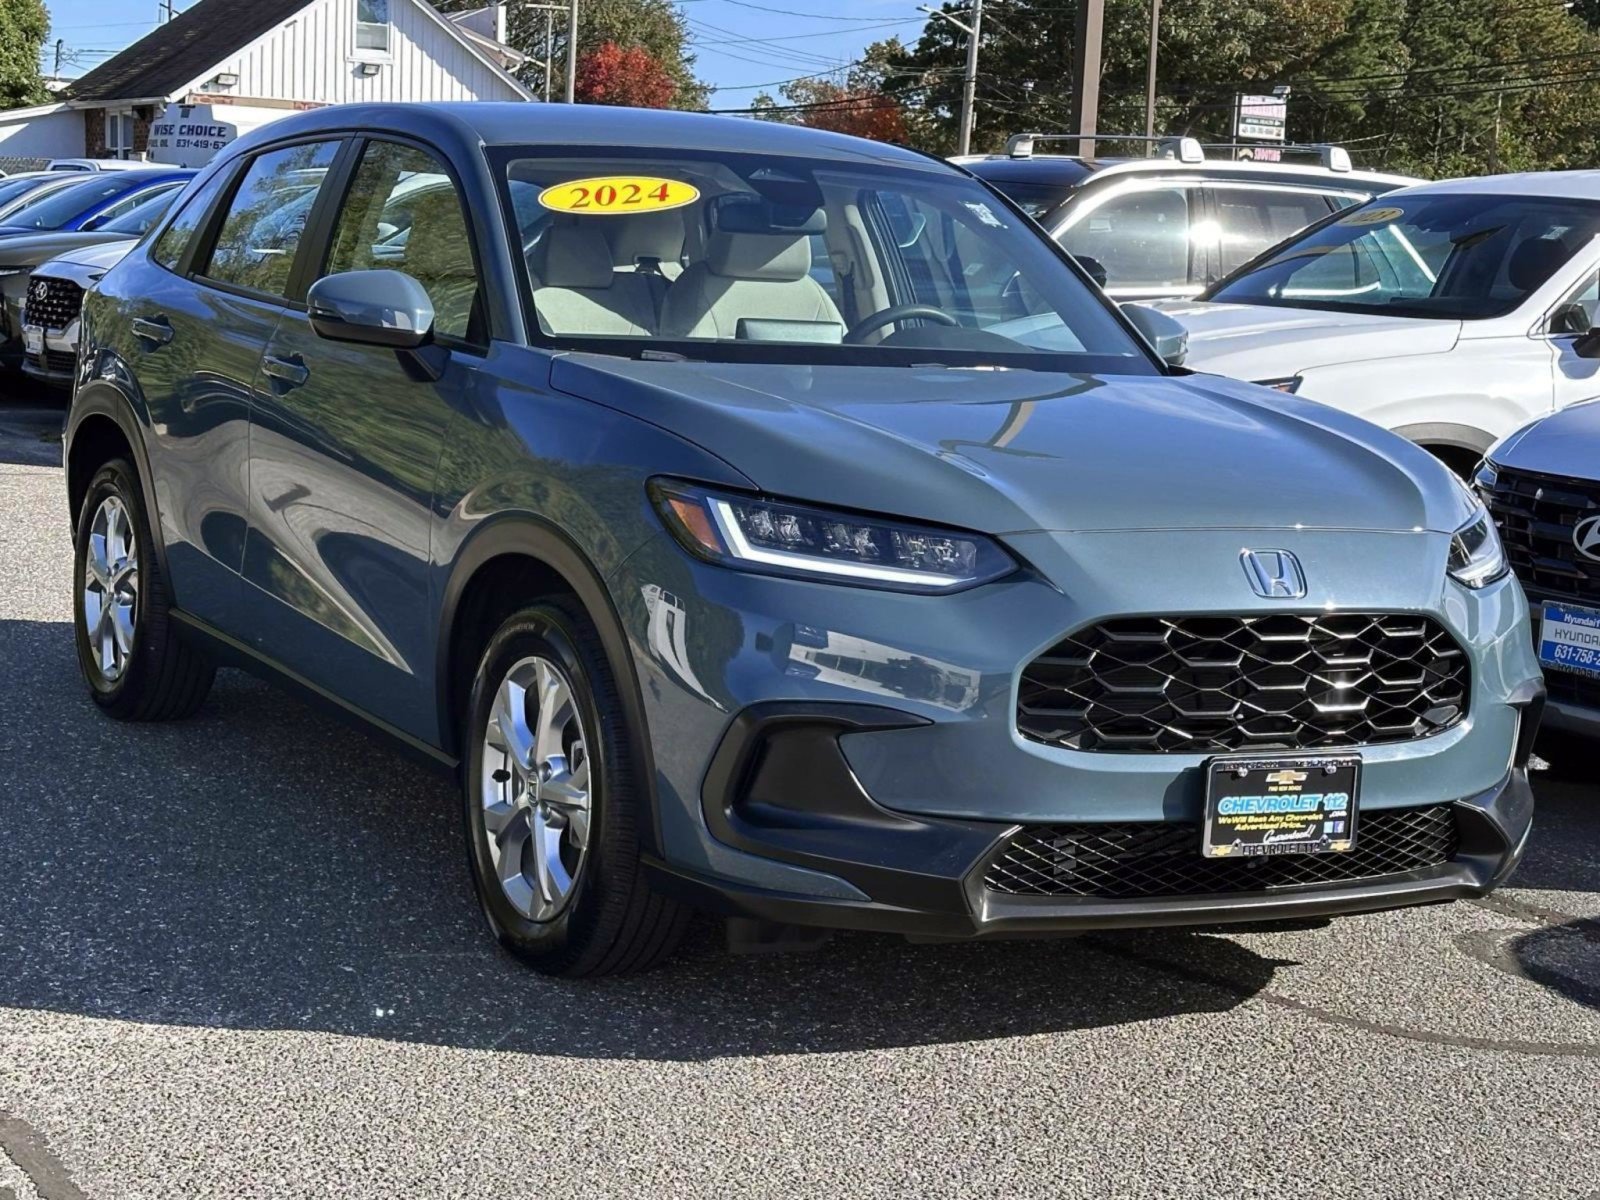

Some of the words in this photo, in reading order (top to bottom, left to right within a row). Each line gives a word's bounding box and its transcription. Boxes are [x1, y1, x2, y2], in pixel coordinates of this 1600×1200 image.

[154, 124, 175, 136] WISE
[179, 124, 227, 138] CHOICE
[569, 182, 670, 209] 2024
[1554, 628, 1600, 646] HYUNDA
[1218, 794, 1322, 815] CHEVROLET
[1323, 792, 1348, 811] 112
